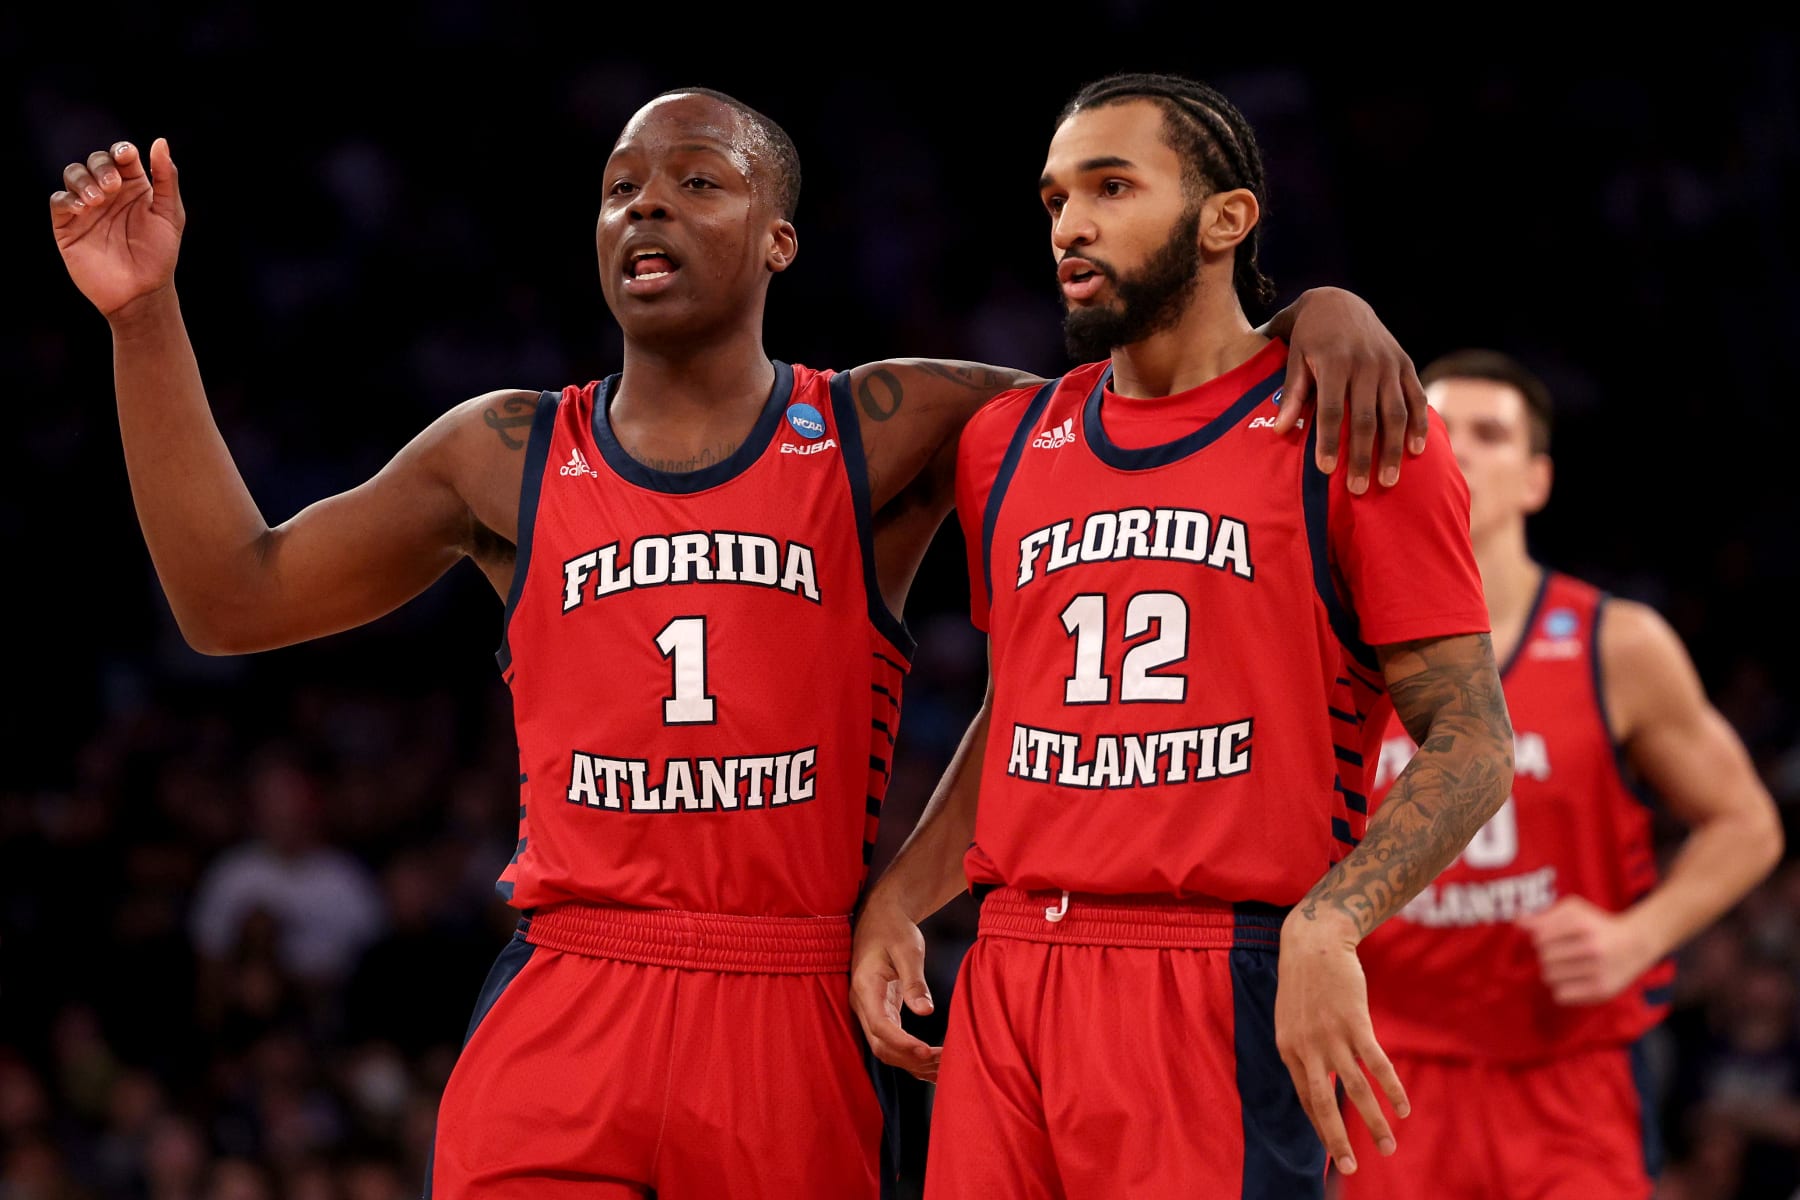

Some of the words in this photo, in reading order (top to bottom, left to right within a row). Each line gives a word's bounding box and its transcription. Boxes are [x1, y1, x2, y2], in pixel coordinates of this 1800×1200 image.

[792, 416, 823, 433] NCAA
[562, 530, 822, 616] FLORIDA
[1015, 506, 1254, 591] FLORIDA
[653, 615, 717, 726] 1
[1058, 590, 1190, 706] 12
[566, 745, 819, 813] ATLANTIC
[1007, 717, 1254, 788] ATLANTIC
